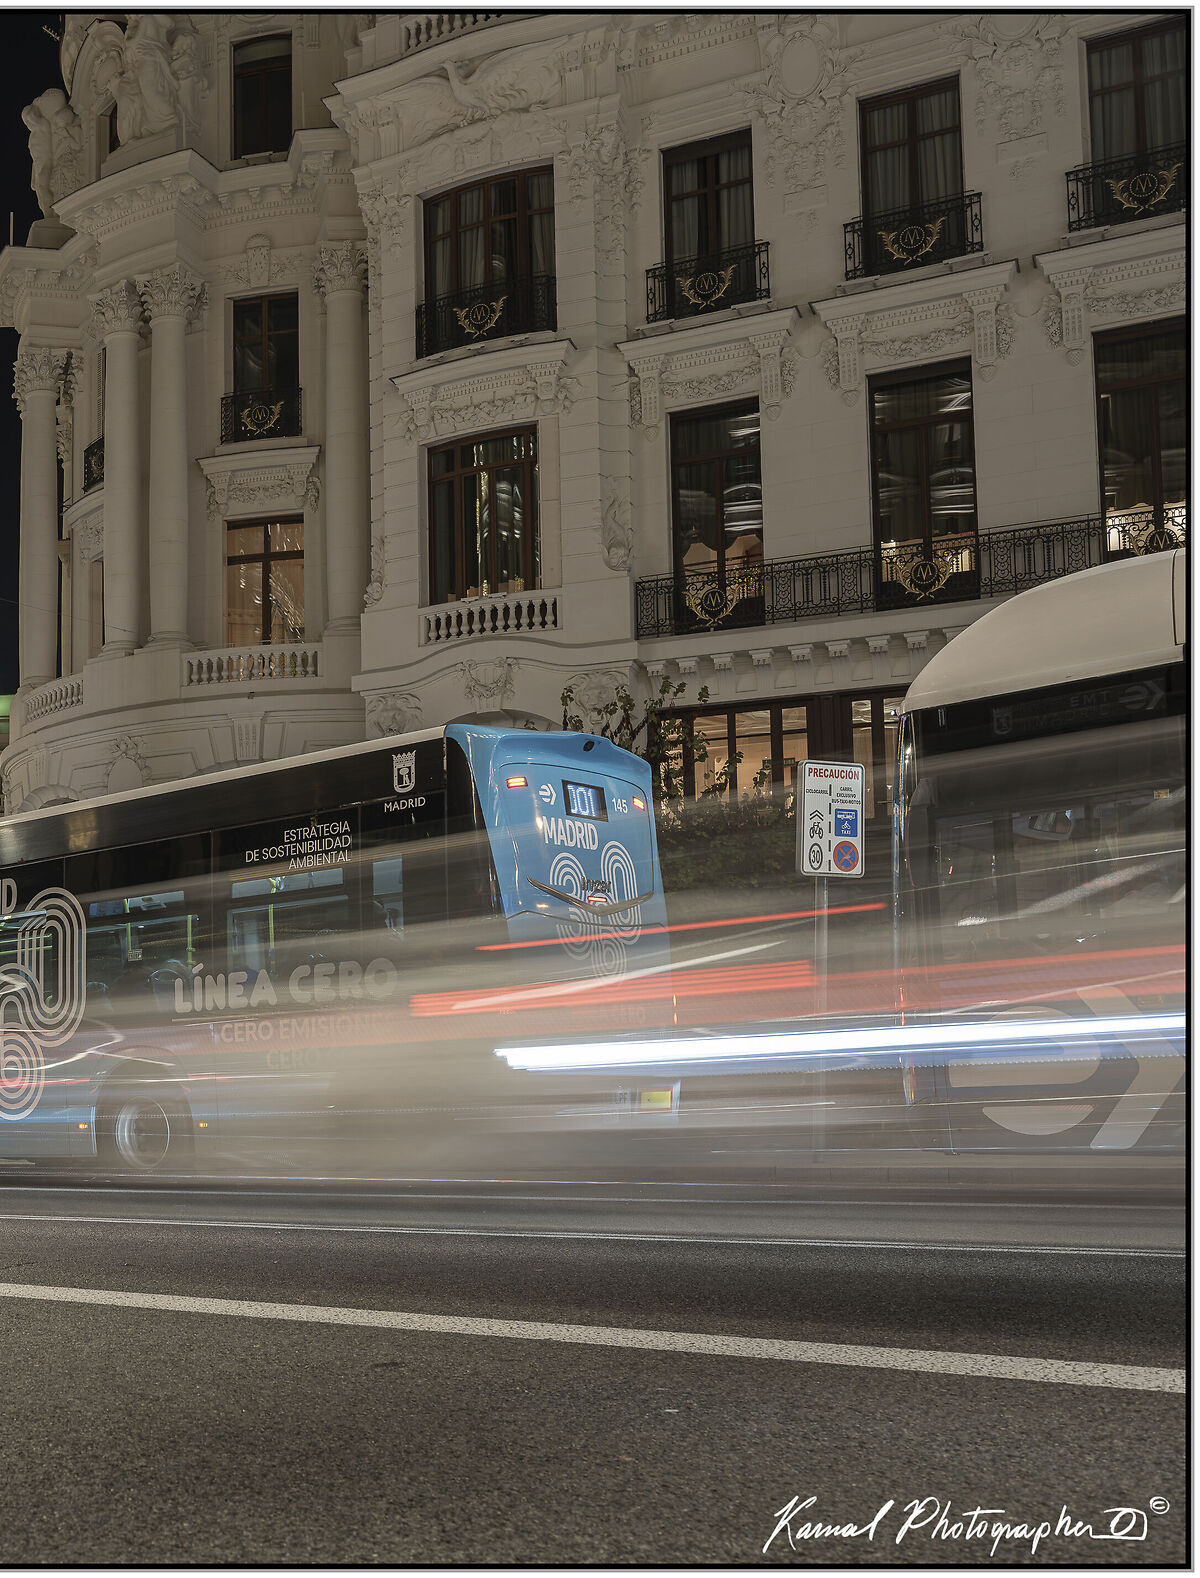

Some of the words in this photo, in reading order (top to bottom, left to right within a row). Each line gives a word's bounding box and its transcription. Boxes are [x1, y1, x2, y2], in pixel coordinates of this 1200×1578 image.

[808, 767, 859, 780] PRECAUCIÓN
[384, 797, 426, 812] MADRID
[612, 797, 628, 814] 145
[284, 821, 350, 842] ESTRATEGIA
[542, 815, 599, 850] MADRID
[245, 850, 259, 863] DE
[262, 835, 351, 860] SOSTENIBILIDAD
[811, 849, 821, 864] 30
[288, 850, 351, 870] AMBIENTAL
[174, 962, 278, 1013] LÍNEA
[288, 957, 398, 1004] CERO
[221, 1022, 273, 1043] CERO
